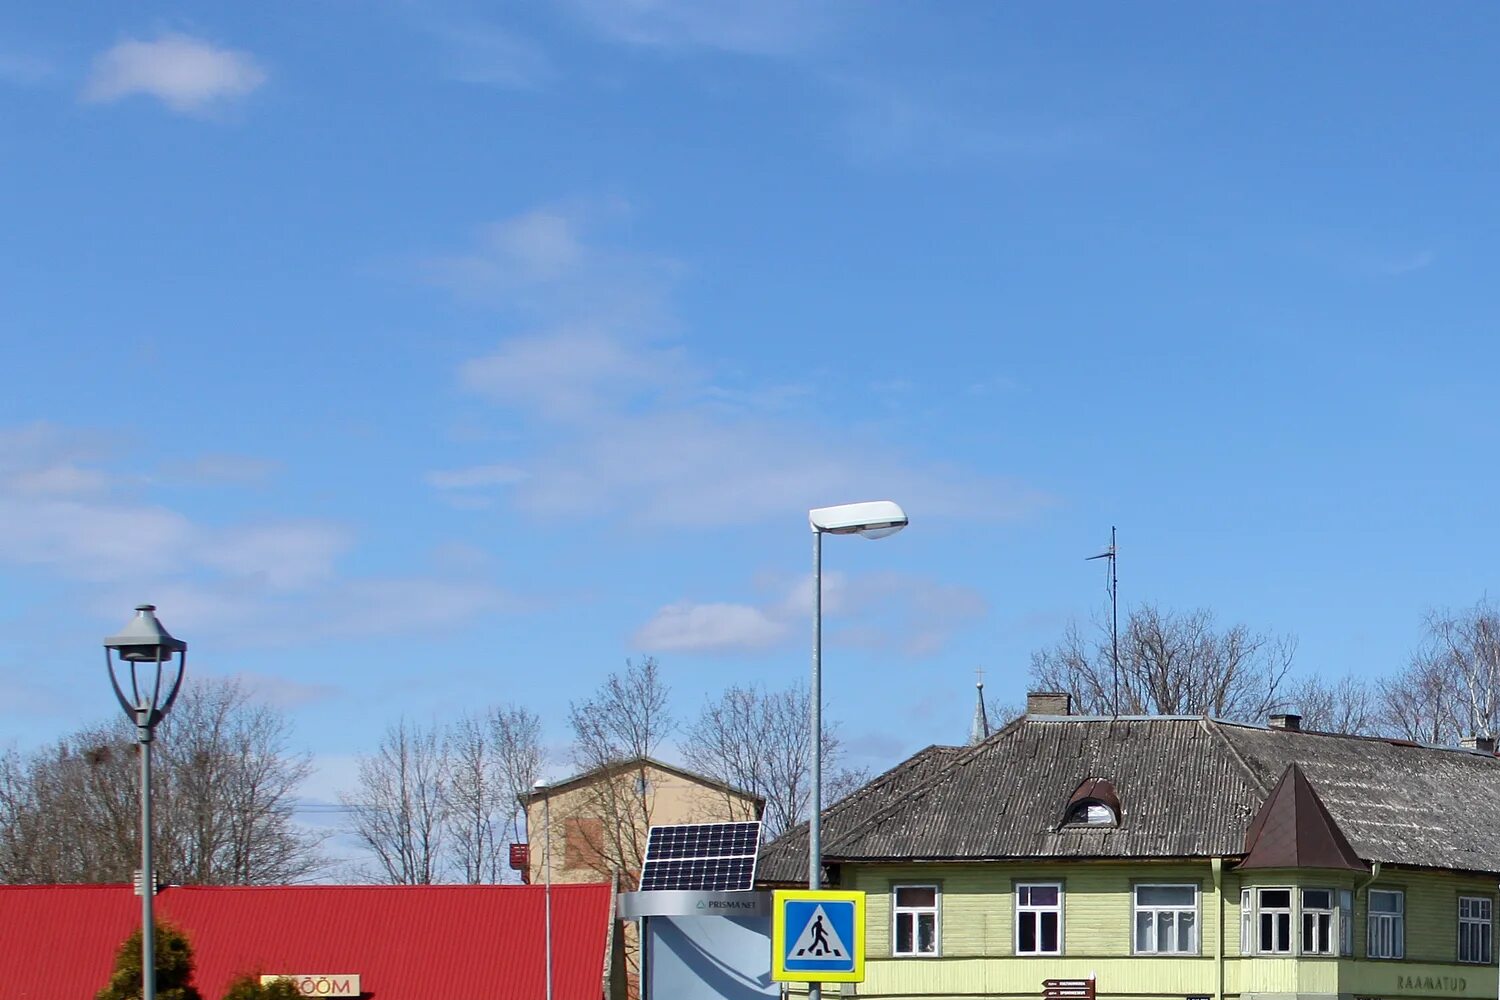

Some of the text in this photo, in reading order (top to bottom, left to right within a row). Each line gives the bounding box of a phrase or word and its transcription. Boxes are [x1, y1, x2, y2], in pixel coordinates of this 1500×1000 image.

[708, 901, 756, 909] PRISMA NET
[1397, 975, 1467, 992] RAAMATUD
